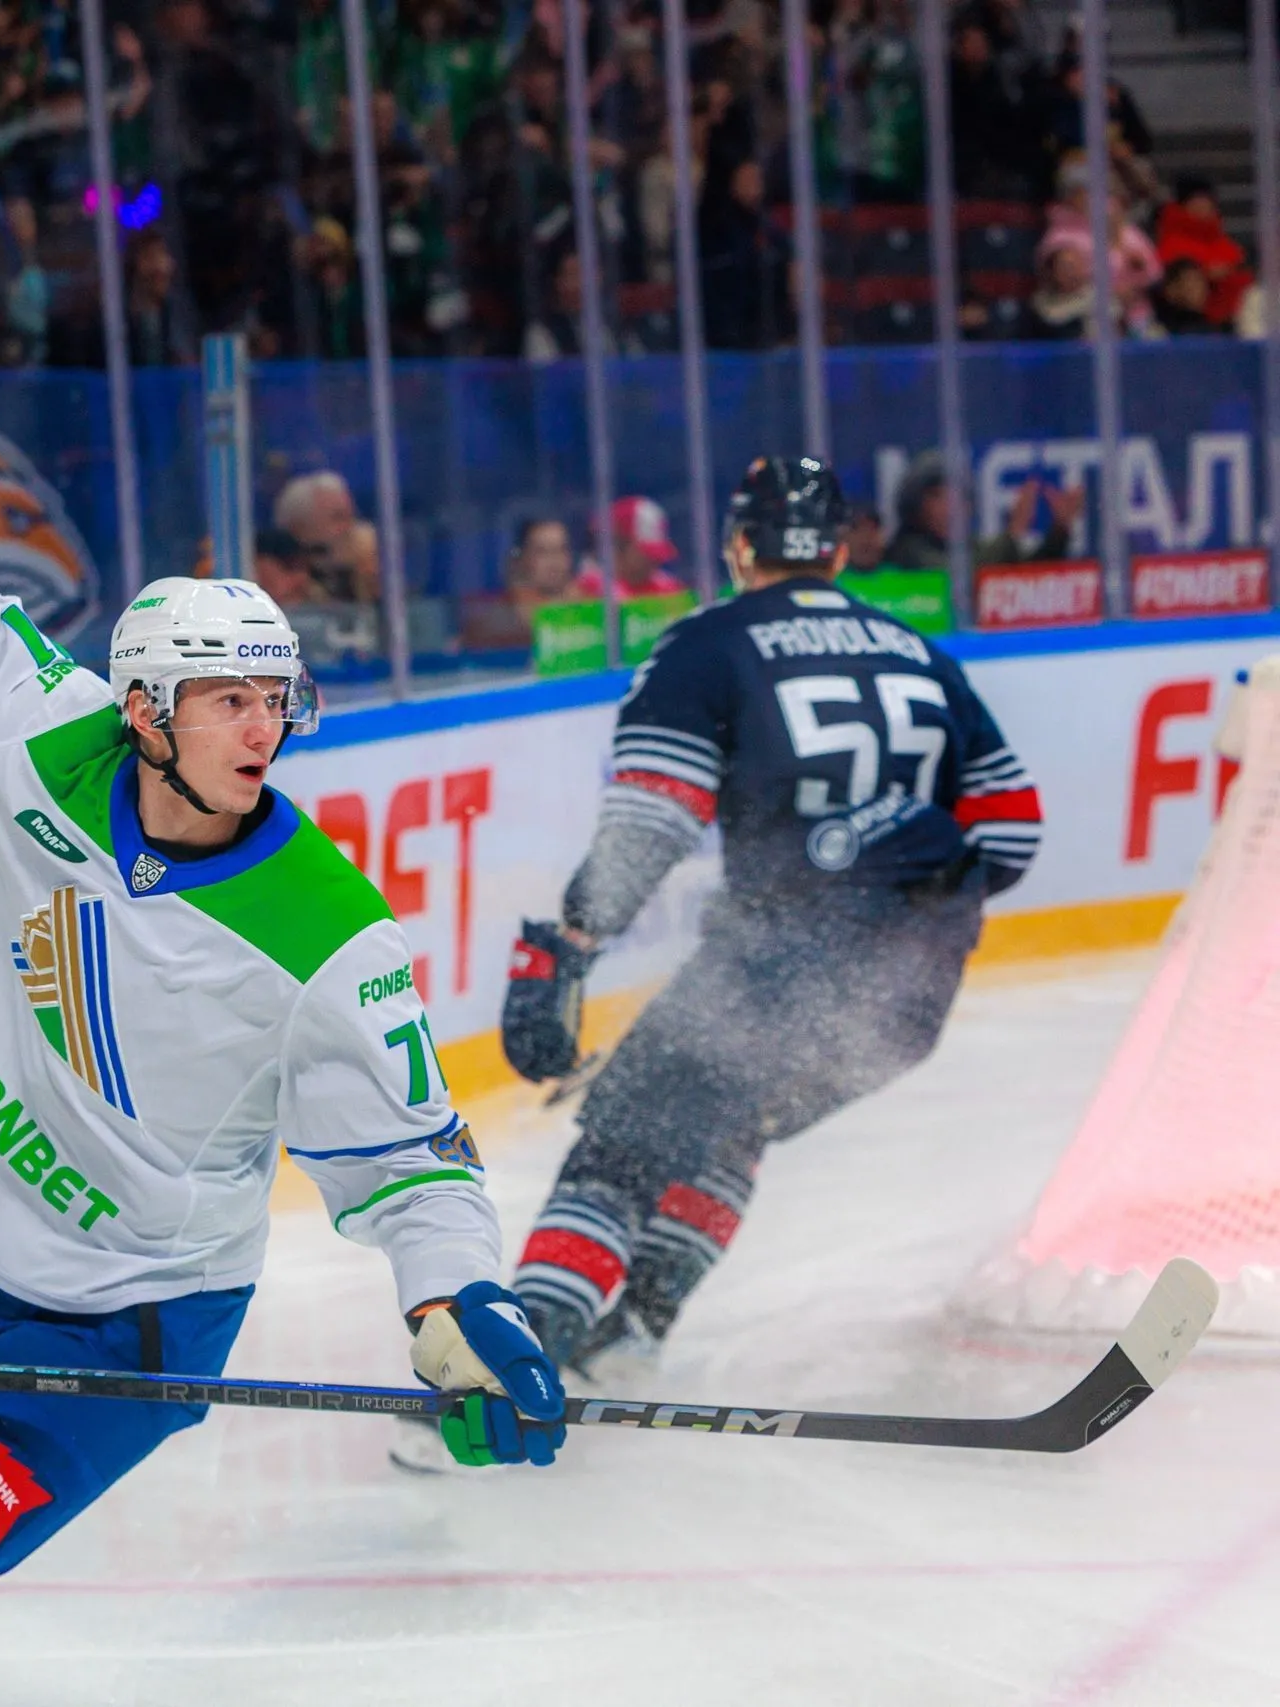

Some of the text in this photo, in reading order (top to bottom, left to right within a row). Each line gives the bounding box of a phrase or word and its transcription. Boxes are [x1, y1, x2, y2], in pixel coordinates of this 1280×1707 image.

[782, 527, 821, 560] 55
[1, 603, 75, 669] 1
[115, 646, 146, 659] CCM
[775, 672, 949, 817] 55
[1123, 680, 1242, 861] F
[358, 963, 413, 1007] FONBE
[383, 1010, 448, 1107] 7
[160, 1382, 345, 1413] RIBCOR
[352, 1394, 424, 1415] TRIGGER
[578, 1399, 803, 1438] CCM
